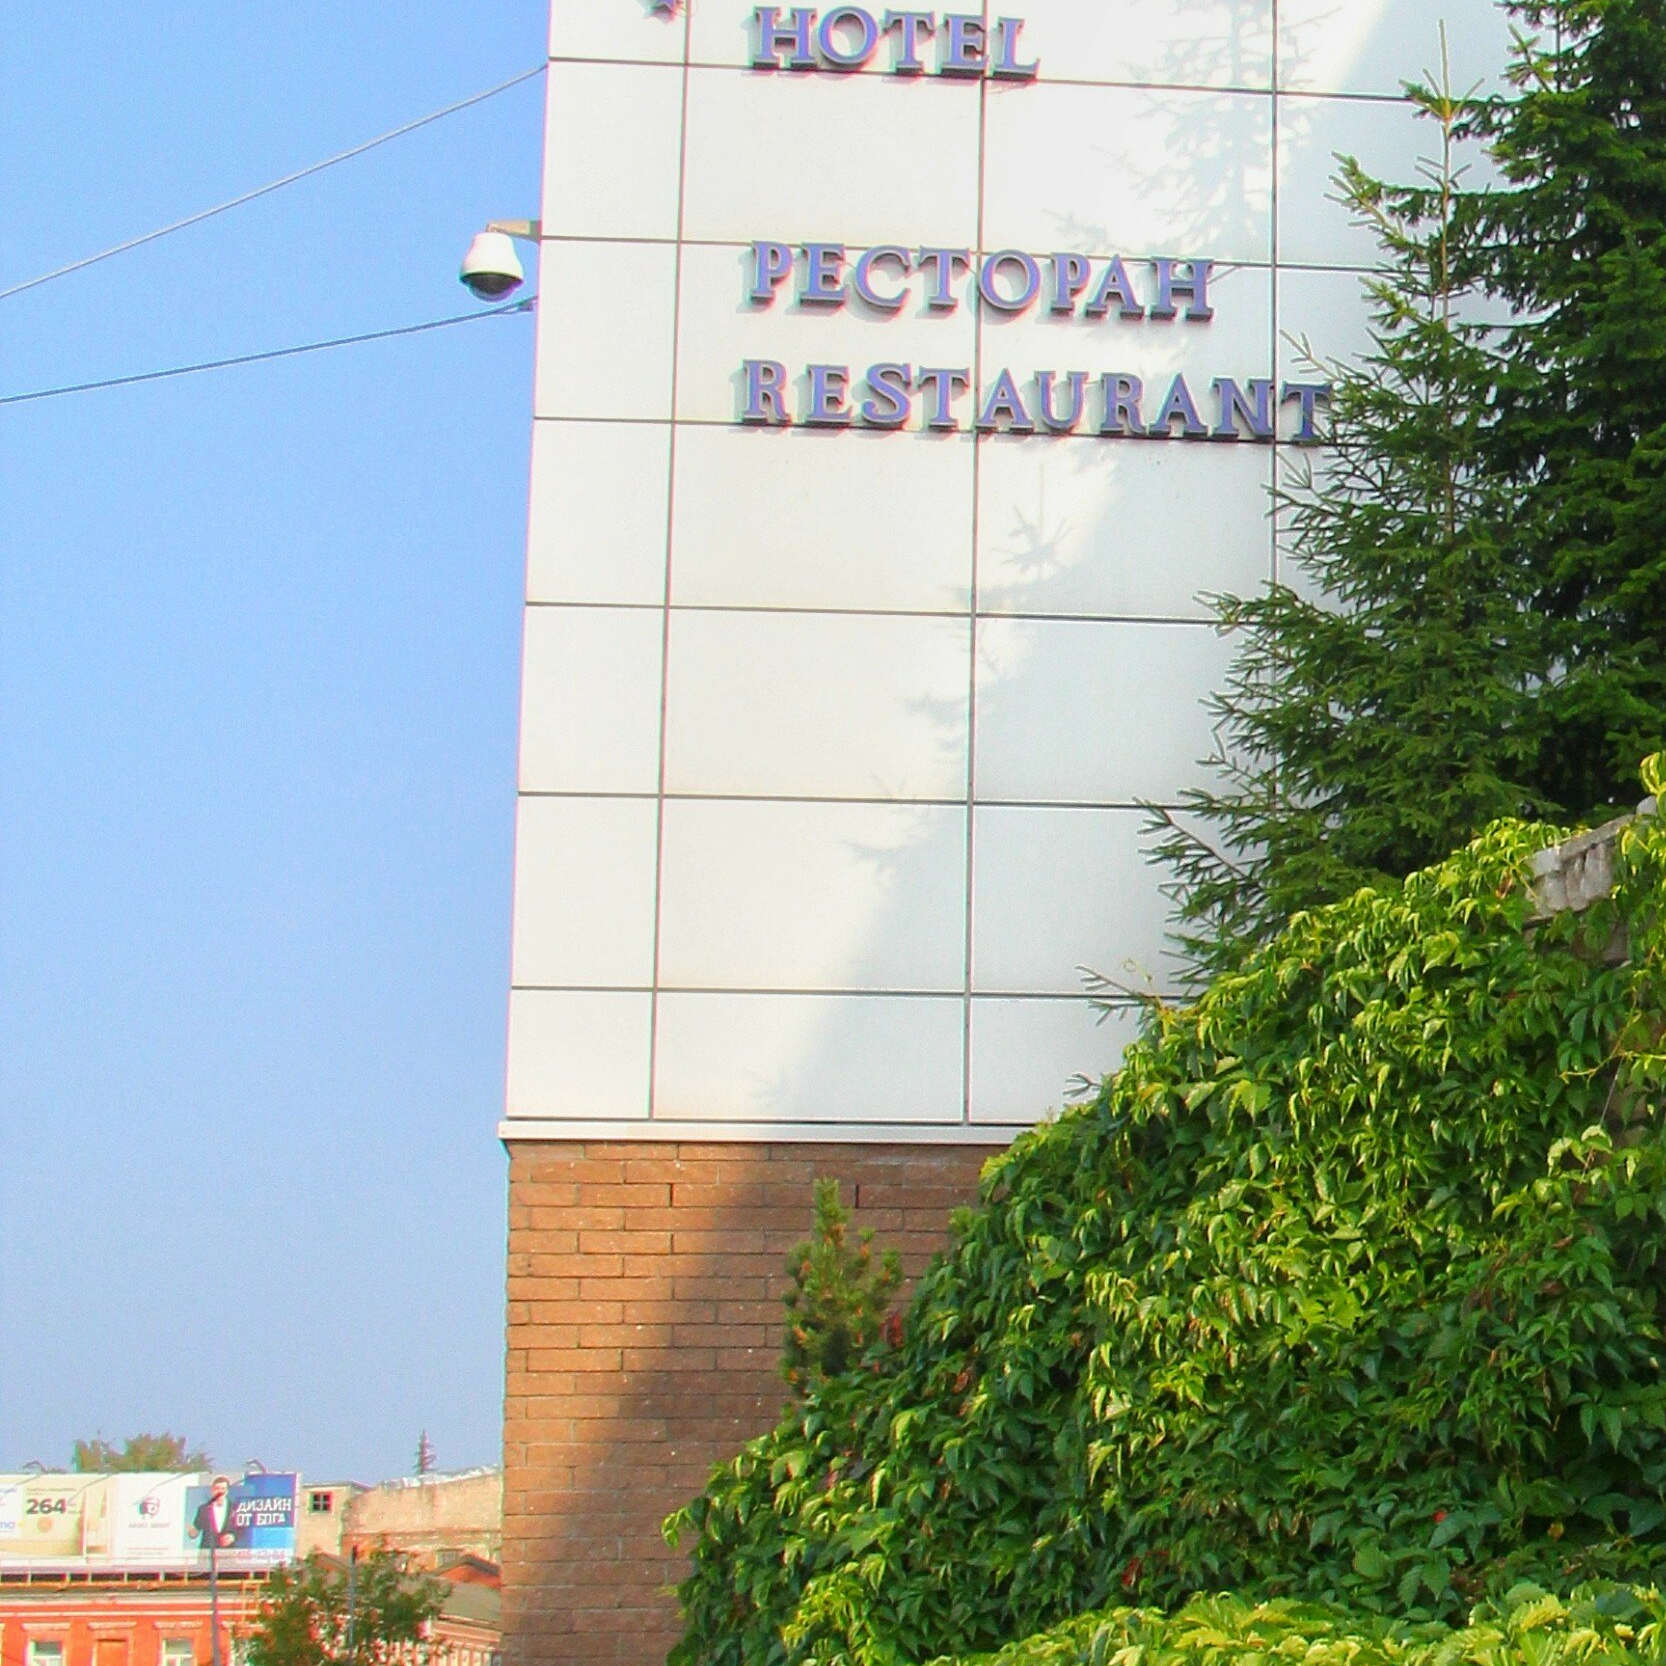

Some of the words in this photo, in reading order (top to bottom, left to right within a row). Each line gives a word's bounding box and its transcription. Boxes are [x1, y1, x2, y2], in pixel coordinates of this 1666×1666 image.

[752, 5, 1040, 79] HOTEL
[750, 240, 1215, 321] РЕСТОРАН
[740, 359, 1334, 445] RESTAURANT
[26, 1498, 67, 1515] 264
[235, 1497, 292, 1513] ДИЗАЙН
[236, 1513, 252, 1527] ОТ
